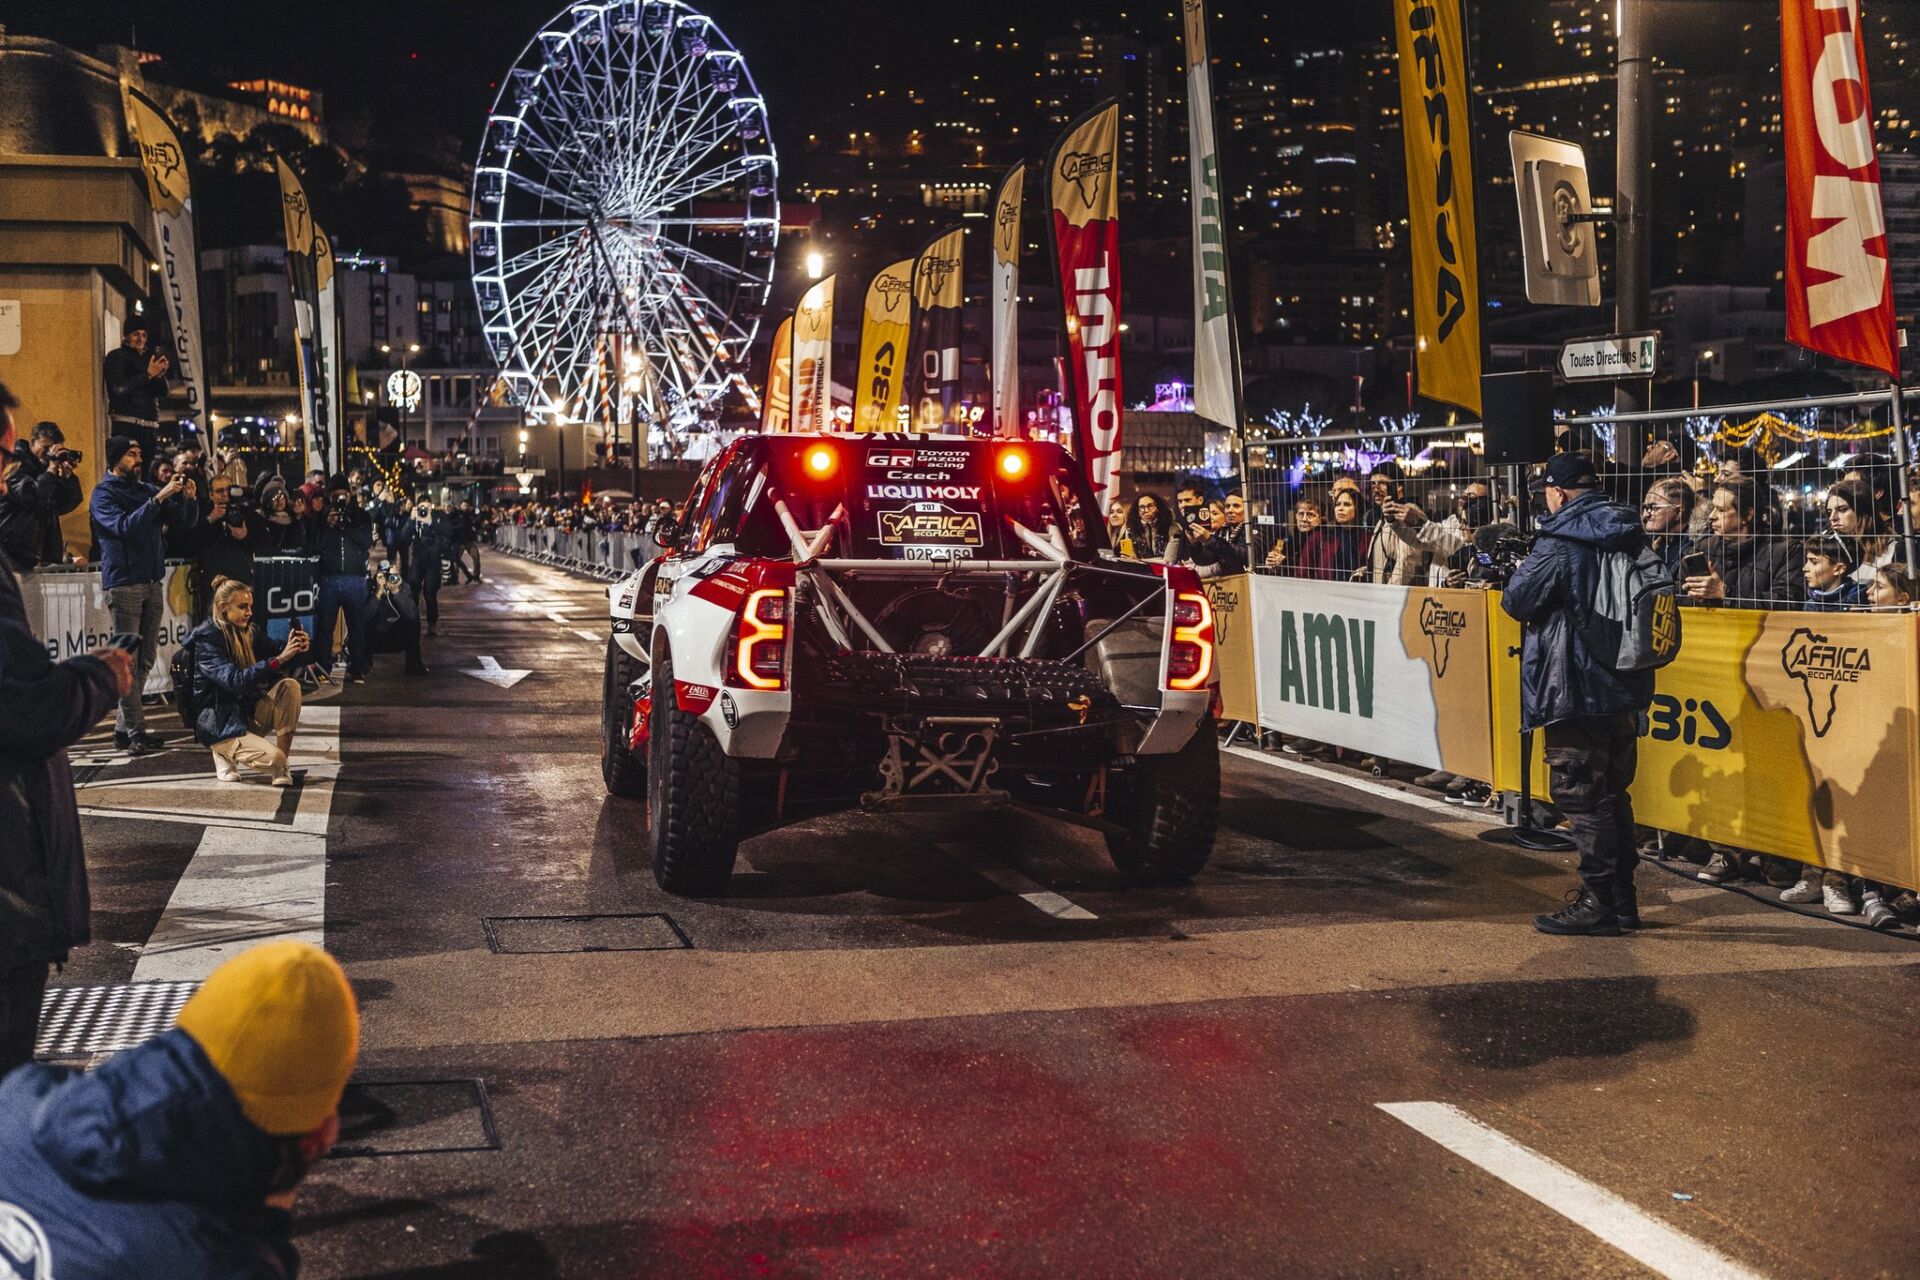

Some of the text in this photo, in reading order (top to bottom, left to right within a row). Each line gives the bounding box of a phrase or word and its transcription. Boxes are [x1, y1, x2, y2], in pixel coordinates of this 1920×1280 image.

[880, 280, 911, 289] AFRIC
[1570, 350, 1637, 368] Toutes Directions
[815, 356, 825, 405] EXPERIENCE
[1074, 251, 1122, 519] MOTUL
[919, 350, 940, 431] Pro
[868, 455, 913, 467] GR
[887, 470, 951, 480] Czech
[867, 485, 981, 499] LIQUI MOLY
[895, 515, 977, 532] AFRICA
[1211, 591, 1239, 606] AFRICA
[1425, 608, 1466, 629] AFRICA
[1790, 644, 1871, 670] AFRICA
